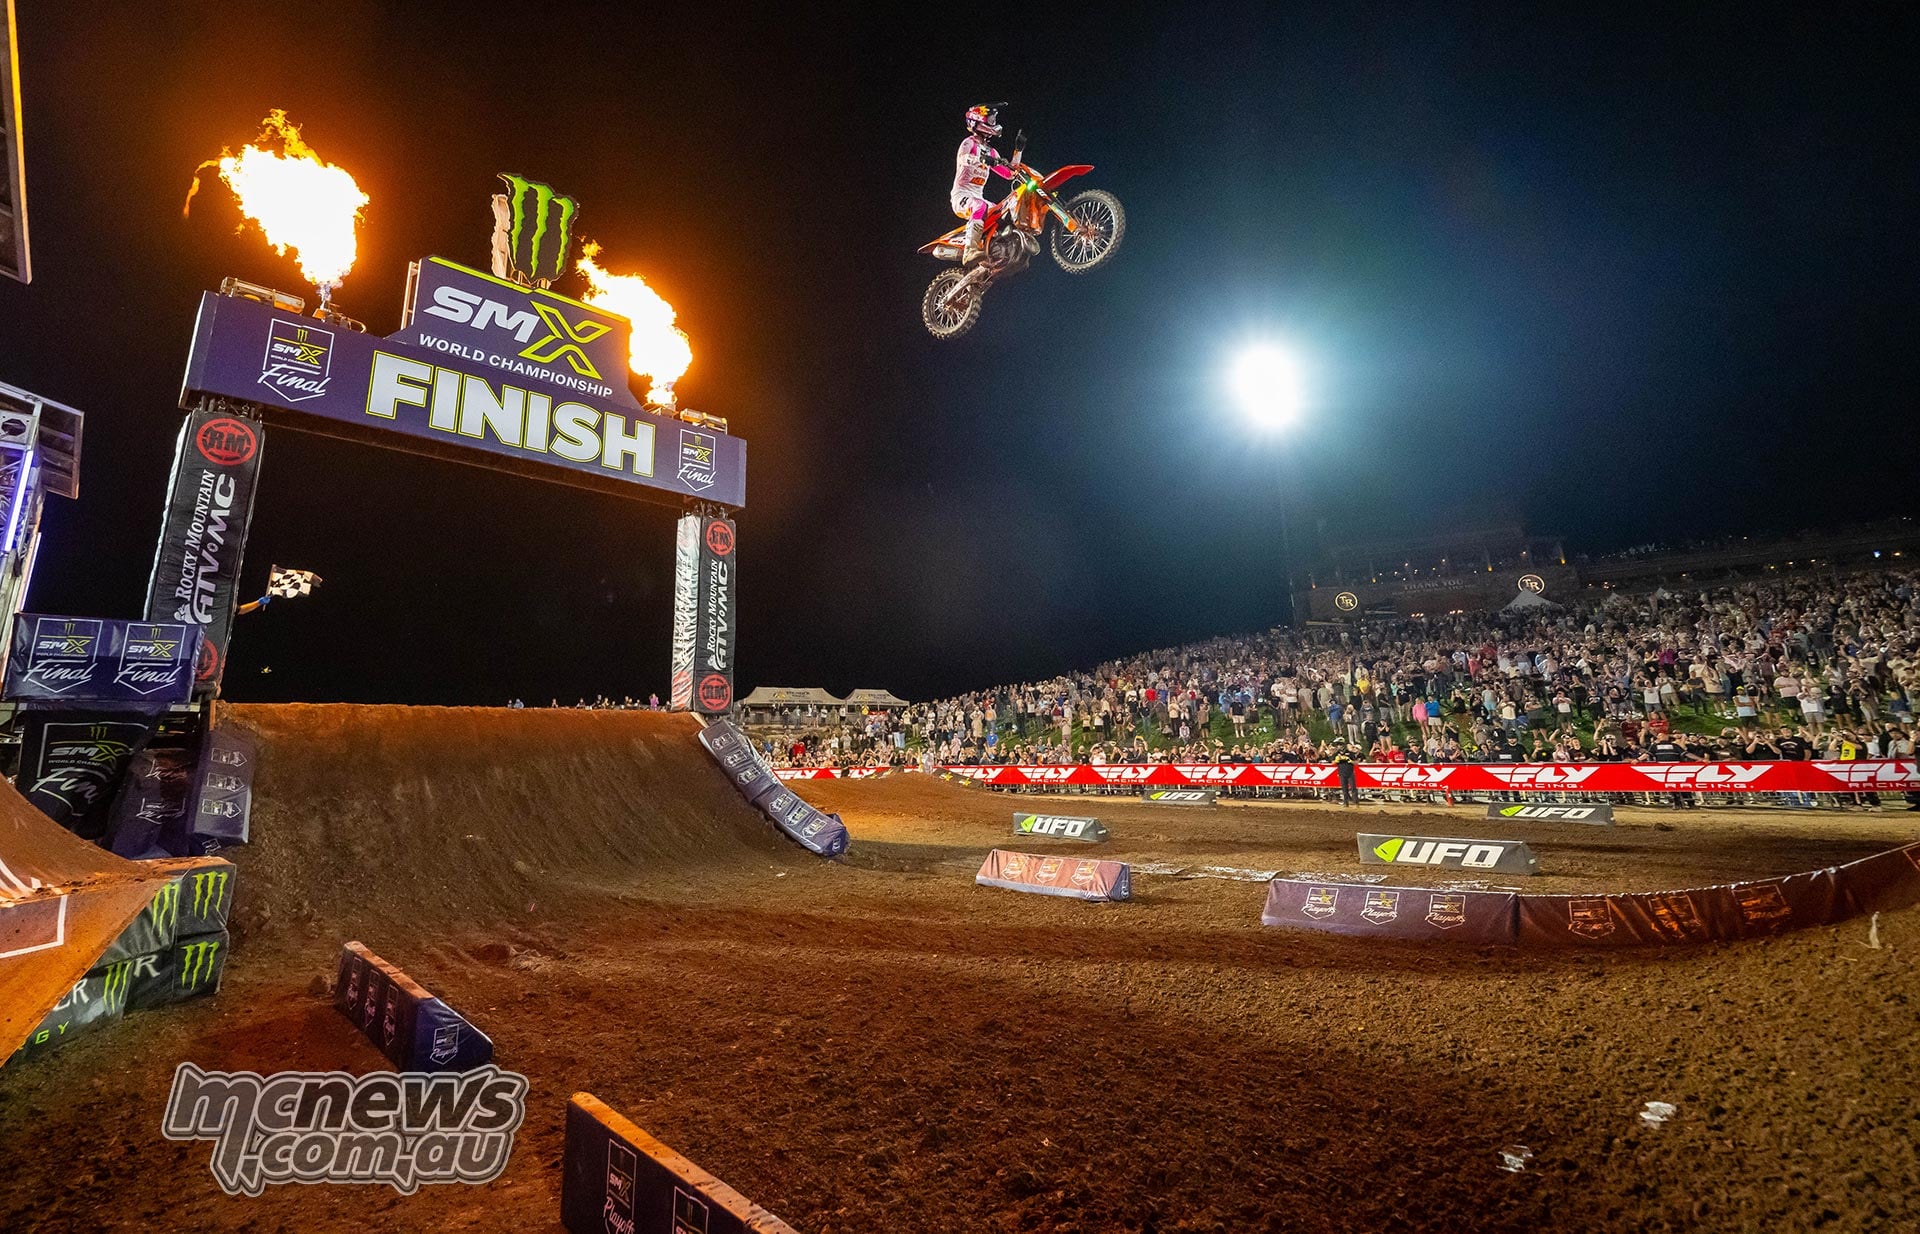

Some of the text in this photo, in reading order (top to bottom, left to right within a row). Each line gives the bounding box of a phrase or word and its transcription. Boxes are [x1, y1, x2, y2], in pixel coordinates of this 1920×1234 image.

[423, 285, 613, 380] SMX
[271, 343, 324, 365] SMX
[419, 333, 613, 398] WORLD CHAMPIONSHIP
[257, 364, 332, 393] Final
[365, 350, 656, 478] FINISH
[677, 463, 716, 484] Final
[175, 469, 216, 601] ROCKY MOUNTAIN
[706, 558, 718, 653] ROCKY MOUNTAIN
[37, 638, 91, 654] SMX
[126, 643, 176, 658] SMX
[22, 659, 98, 682] Final
[113, 662, 182, 683] Final
[1017, 767, 1078, 779] FLY
[1091, 766, 1158, 779] FLY
[1173, 766, 1248, 779] FLY
[1254, 766, 1338, 780] FLY
[1359, 767, 1456, 782] FLY
[1482, 766, 1600, 782] FLY
[1630, 764, 1774, 782] FLY
[1158, 791, 1206, 800] UFO
[1516, 806, 1595, 819] UFO
[1031, 817, 1086, 837] UFO
[1396, 840, 1505, 868] UFO
